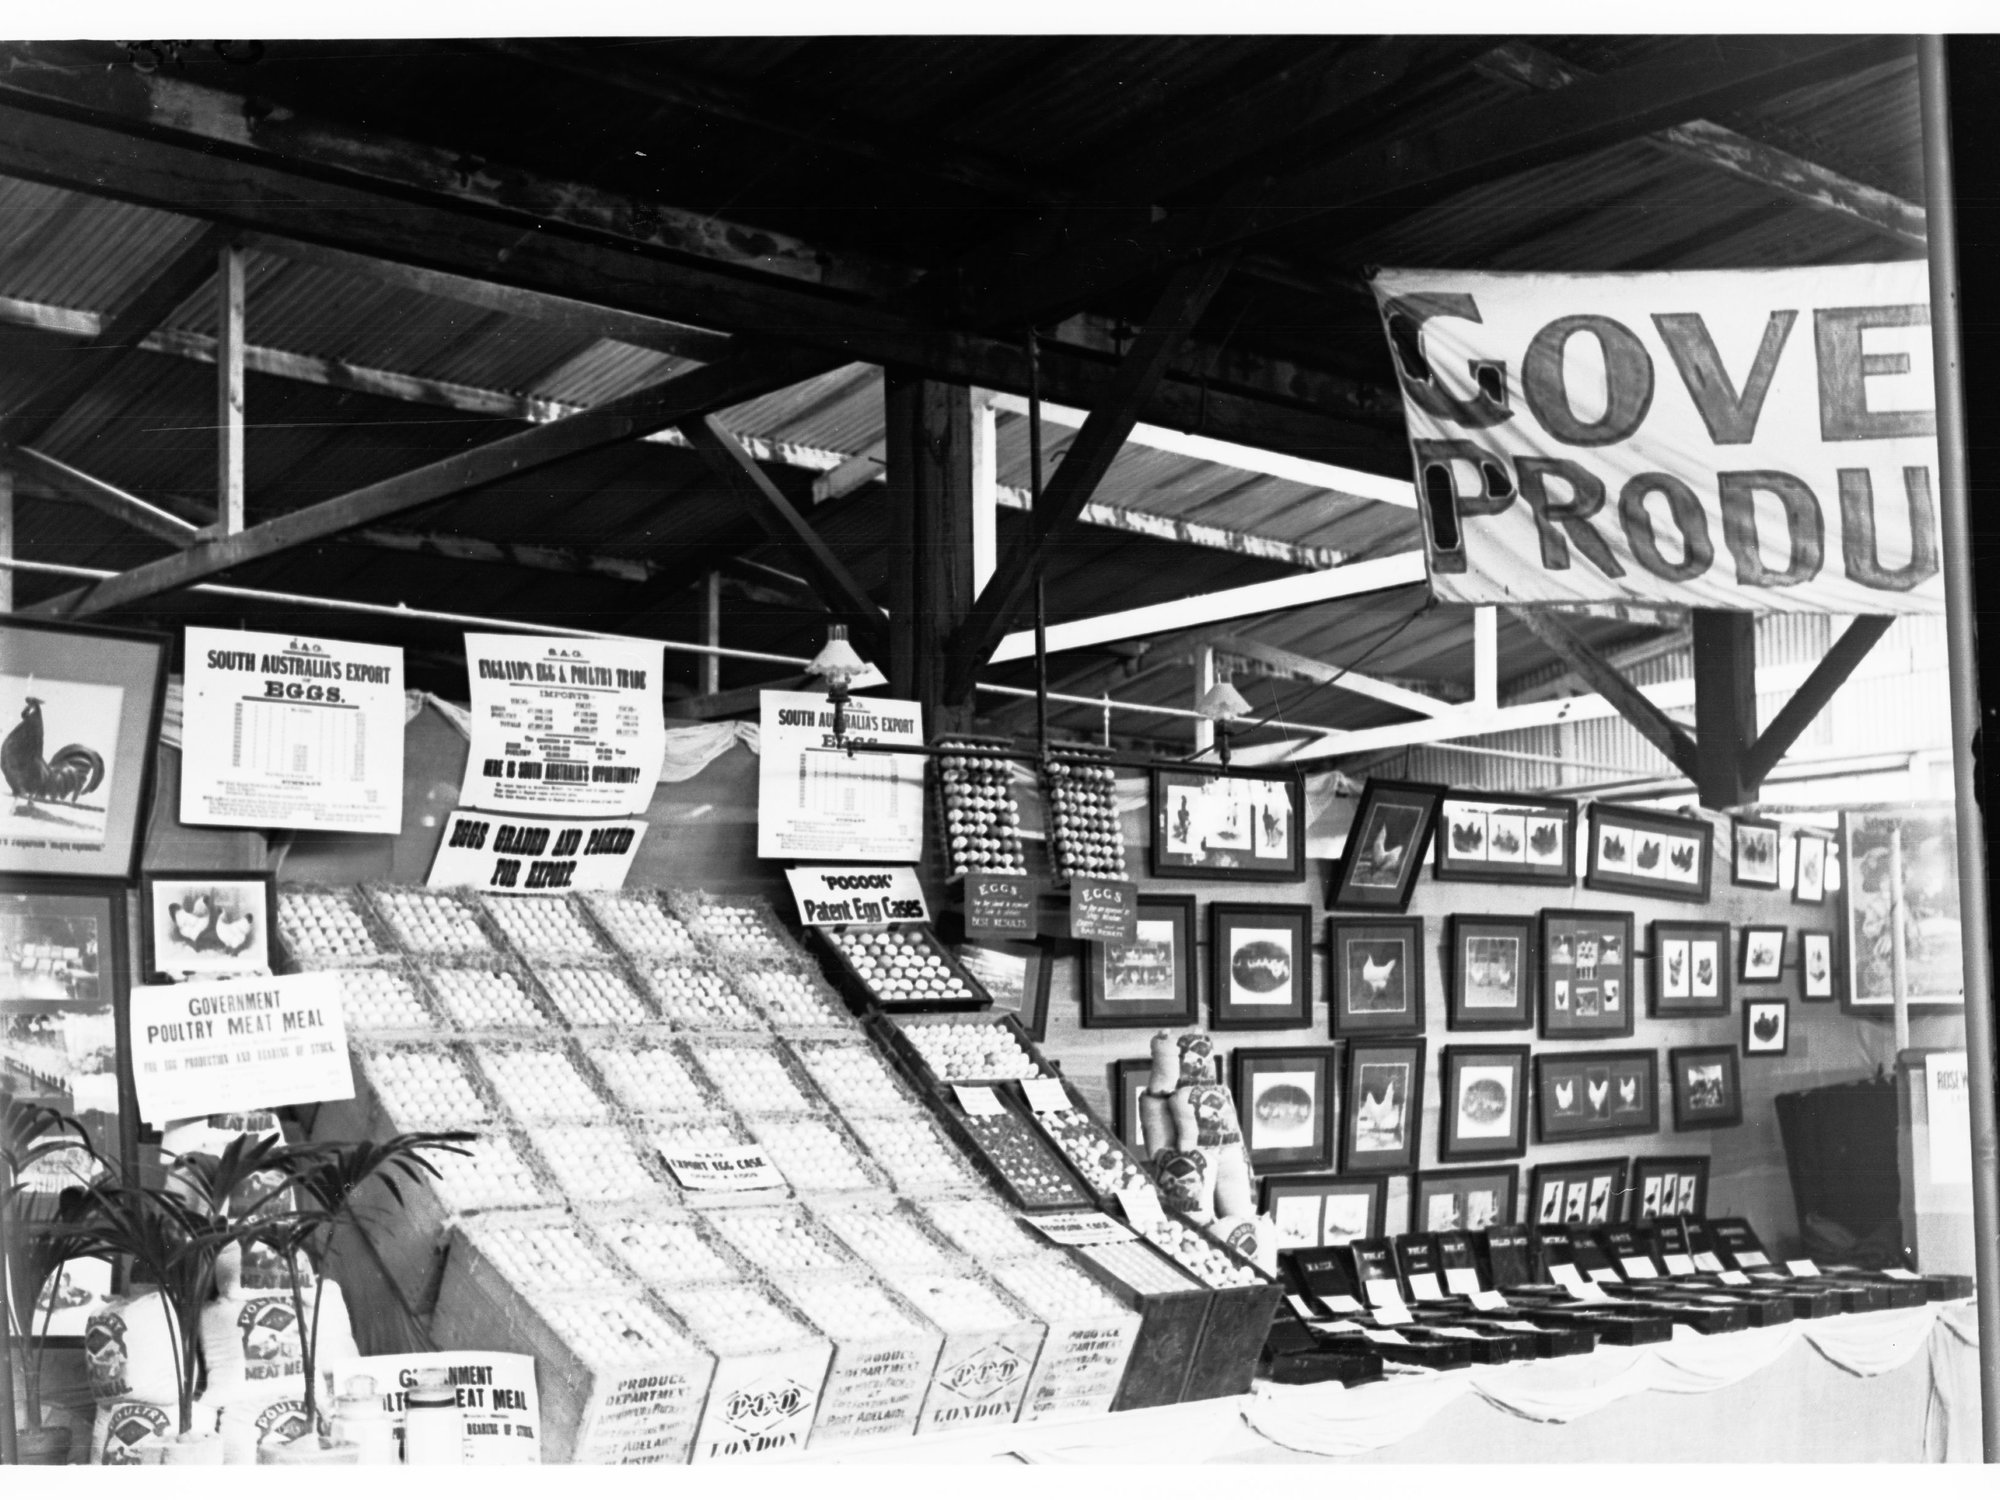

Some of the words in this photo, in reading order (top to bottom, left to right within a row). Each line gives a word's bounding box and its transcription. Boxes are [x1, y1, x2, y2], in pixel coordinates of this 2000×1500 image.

[207, 650, 256, 672] SOUTH
[261, 654, 341, 680] AUSTRALIA'S
[346, 662, 391, 684] EXPORT
[478, 659, 534, 681] ENGLAND'S
[536, 662, 556, 682] EGG
[559, 664, 568, 684] &
[570, 665, 613, 687] POULTRY
[615, 668, 647, 690] TRADE
[264, 680, 346, 704] EGGS.
[778, 709, 816, 727] SOUTH
[881, 716, 915, 734] EXPORT
[482, 759, 504, 778] HERE
[506, 760, 517, 778] IS
[518, 761, 544, 780] SOUTH
[545, 763, 590, 782] AUSTRALIA'S
[448, 819, 490, 851] EGGS
[493, 824, 551, 857] GRADED
[551, 828, 584, 857] AND
[583, 827, 635, 856] PACKED
[490, 858, 521, 887] FOR
[978, 883, 1018, 897] EGGS
[1082, 887, 1123, 904] EGGS
[803, 899, 854, 922] Patent
[852, 897, 883, 923] Egg
[881, 895, 925, 919] Cases
[187, 989, 281, 1018] GOVERNMENT
[146, 1019, 214, 1045] POULTRY
[226, 1013, 272, 1036] MEAT
[281, 1008, 325, 1033] MEAL
[617, 1374, 687, 1393] PRODUCE
[455, 1388, 484, 1408] EAT
[492, 1388, 528, 1411] MEAL
[934, 1401, 1012, 1424] LONDON
[710, 1432, 798, 1458] LONDON
